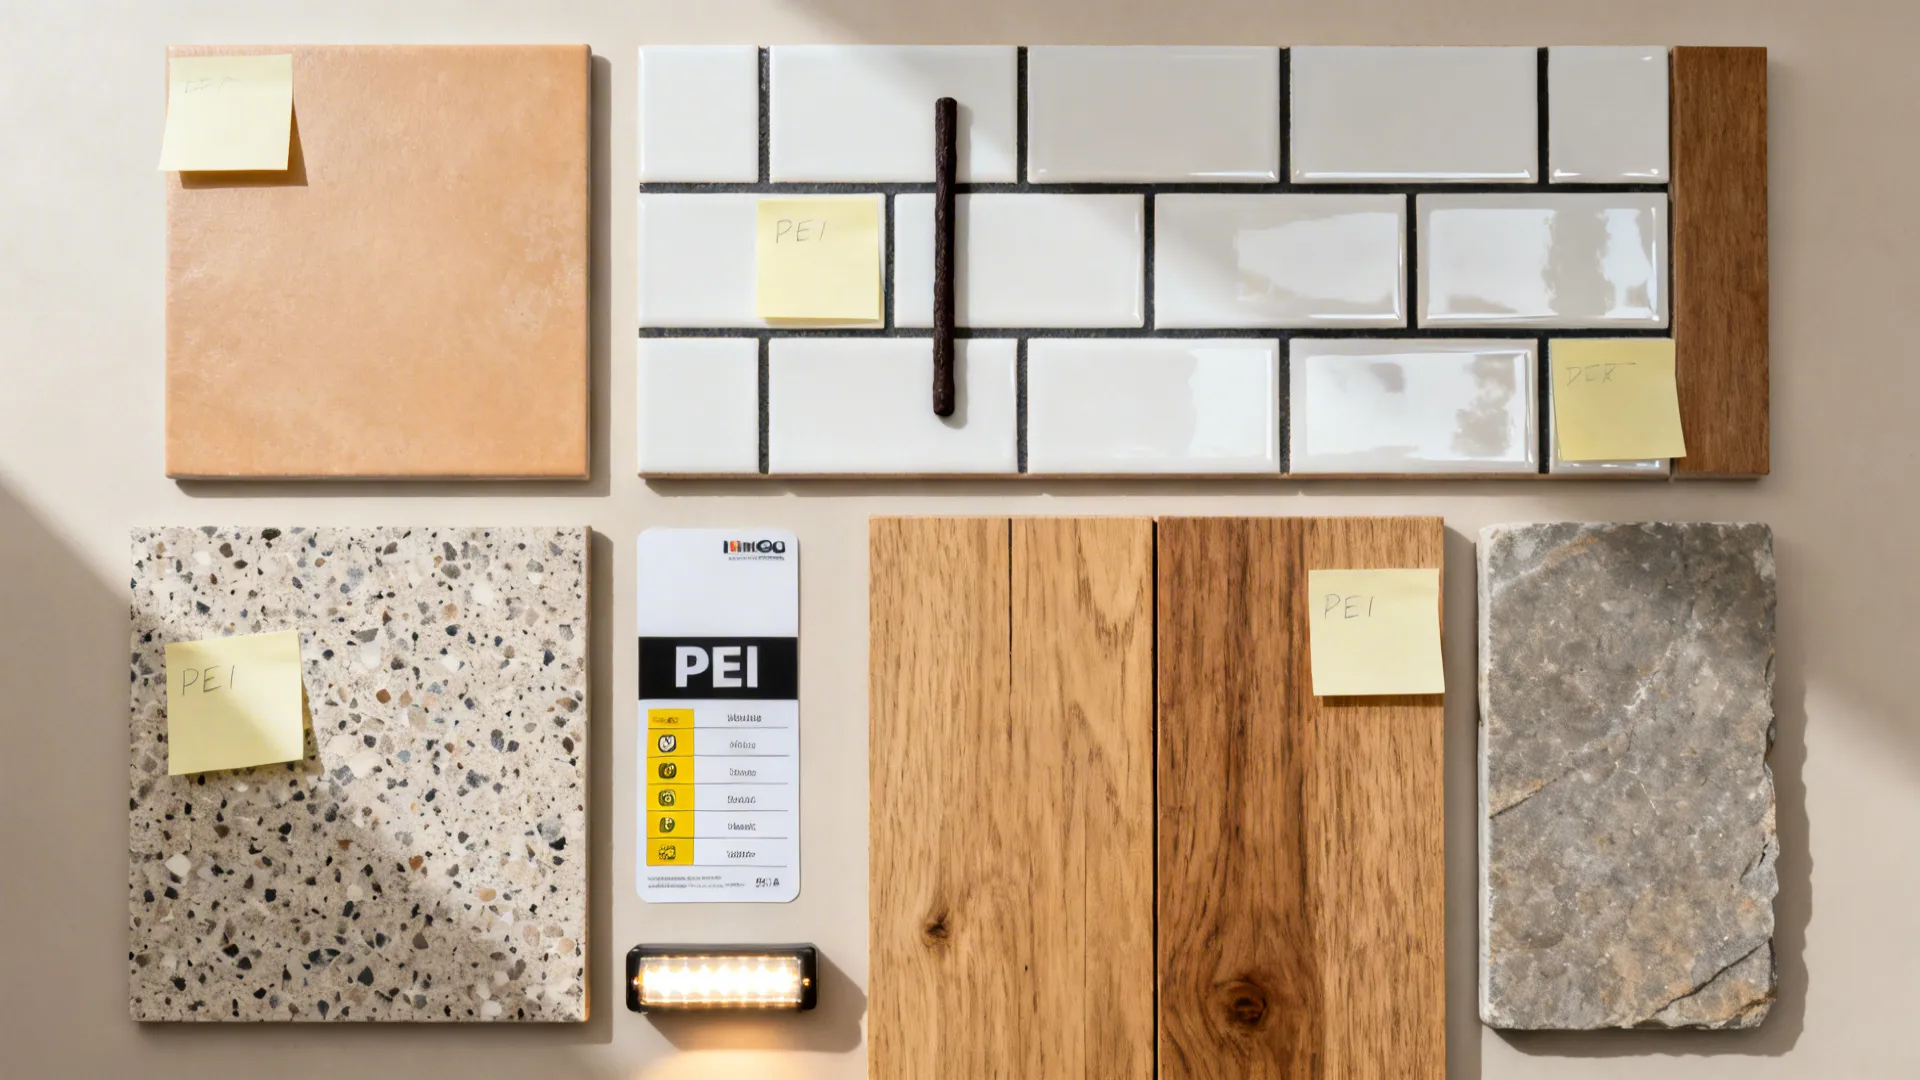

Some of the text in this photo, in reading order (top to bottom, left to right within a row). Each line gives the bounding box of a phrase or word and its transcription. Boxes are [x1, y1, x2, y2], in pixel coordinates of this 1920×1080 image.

[775, 218, 827, 245] PEI
[1324, 593, 1375, 620] PEI
[181, 664, 235, 696] PEI
[675, 645, 759, 688] PEI
